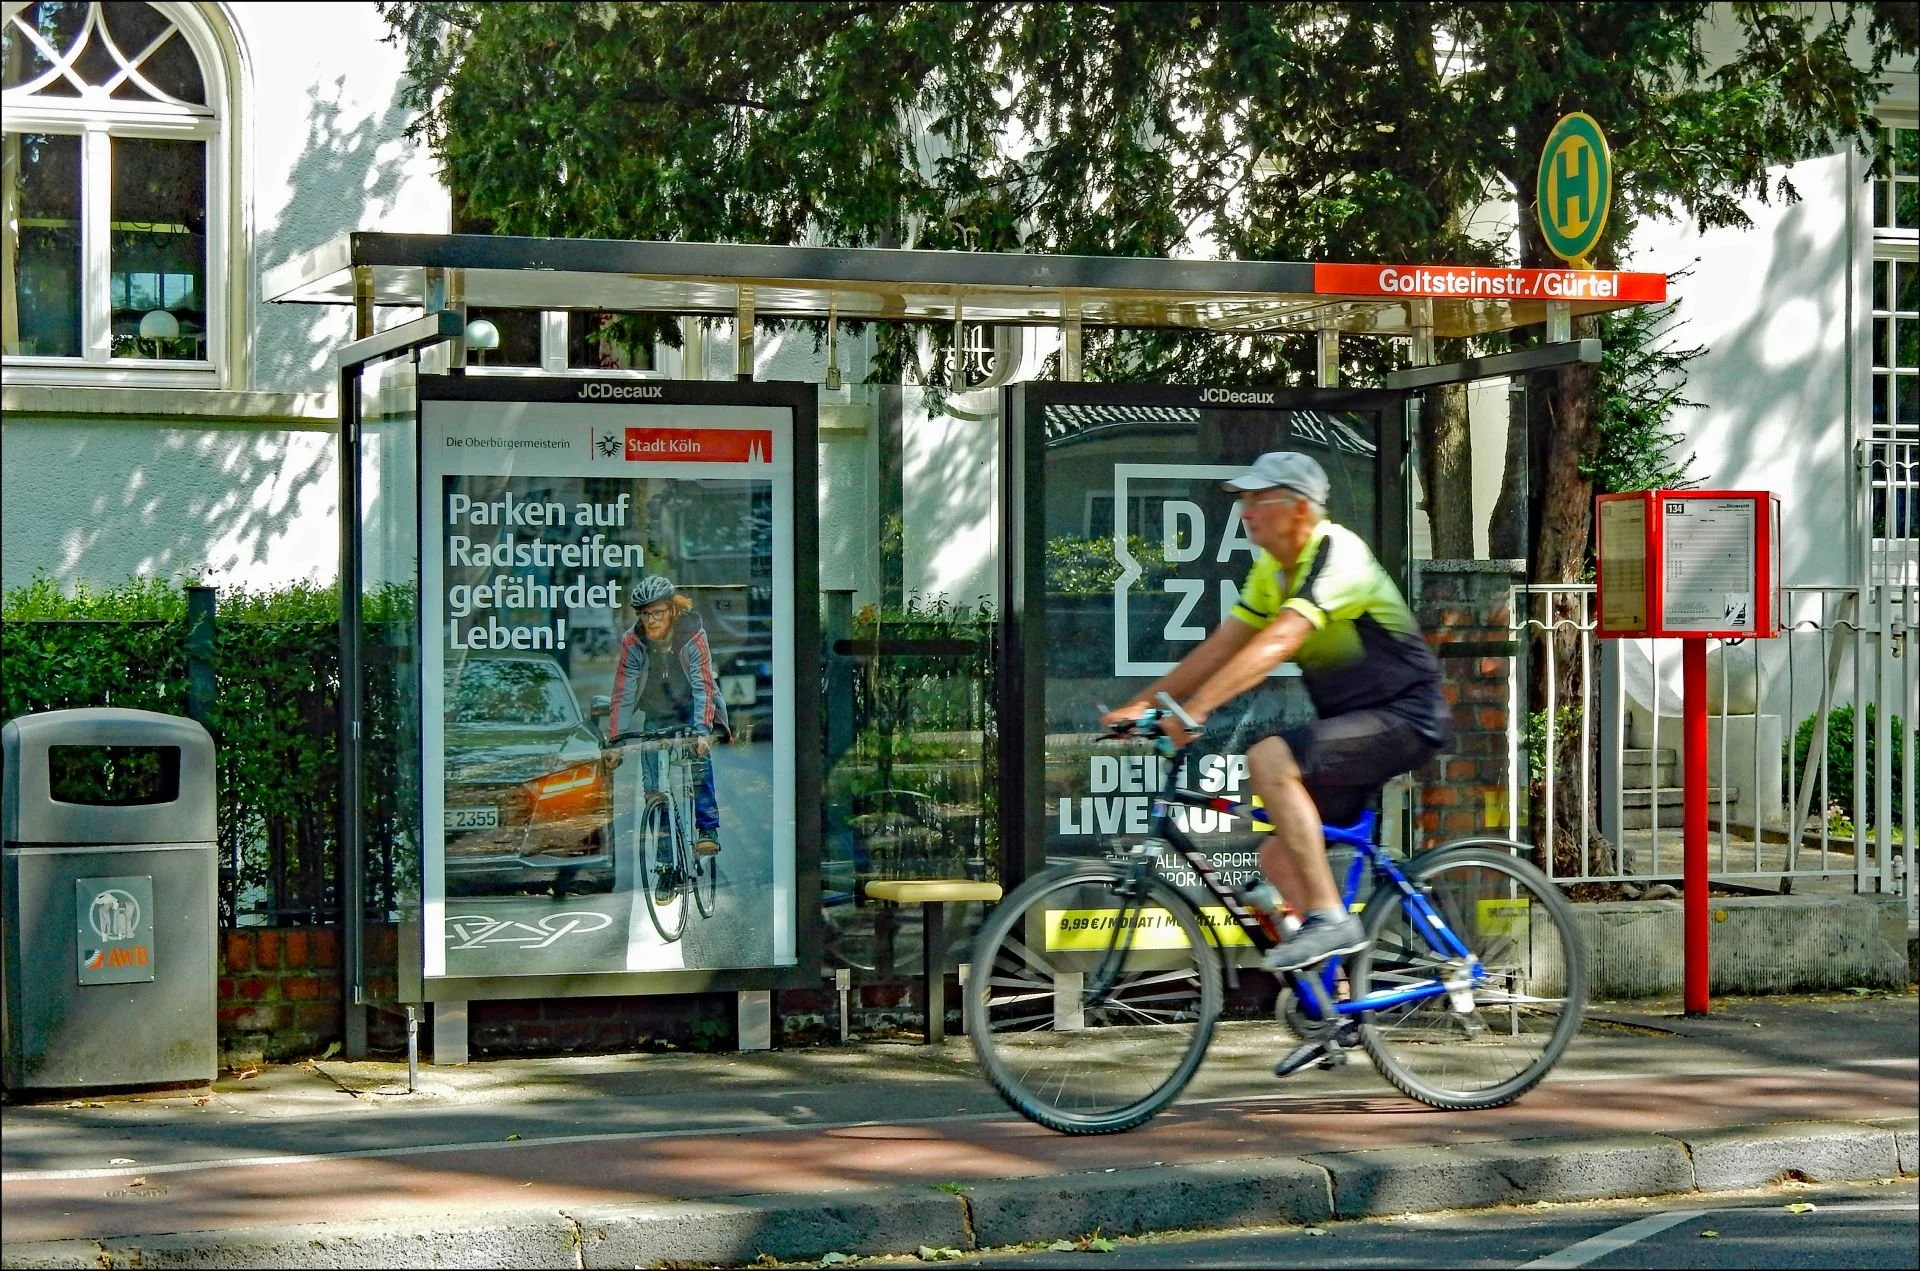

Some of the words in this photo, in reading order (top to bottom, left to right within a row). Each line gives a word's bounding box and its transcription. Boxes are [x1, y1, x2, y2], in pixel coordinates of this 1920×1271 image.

[1557, 145, 1590, 228] H
[1378, 268, 1618, 297] Goltsteinstr./Gürtel
[578, 383, 663, 399] JCDecaux
[1199, 388, 1275, 404] JCDecaux
[446, 437, 463, 447] Die
[465, 437, 570, 450] Oberbürgermeisterin
[628, 438, 667, 452] Stadt
[669, 438, 701, 453] Köln
[449, 492, 566, 526] Parken
[574, 494, 630, 526] auf
[1668, 504, 1683, 514] 134
[449, 534, 644, 568] Radstreifen
[449, 575, 622, 618] gefährdet
[449, 618, 567, 650] Leben!
[457, 811, 496, 827] 2355
[1059, 796, 1149, 834] LIVE
[107, 944, 148, 968] AWB
